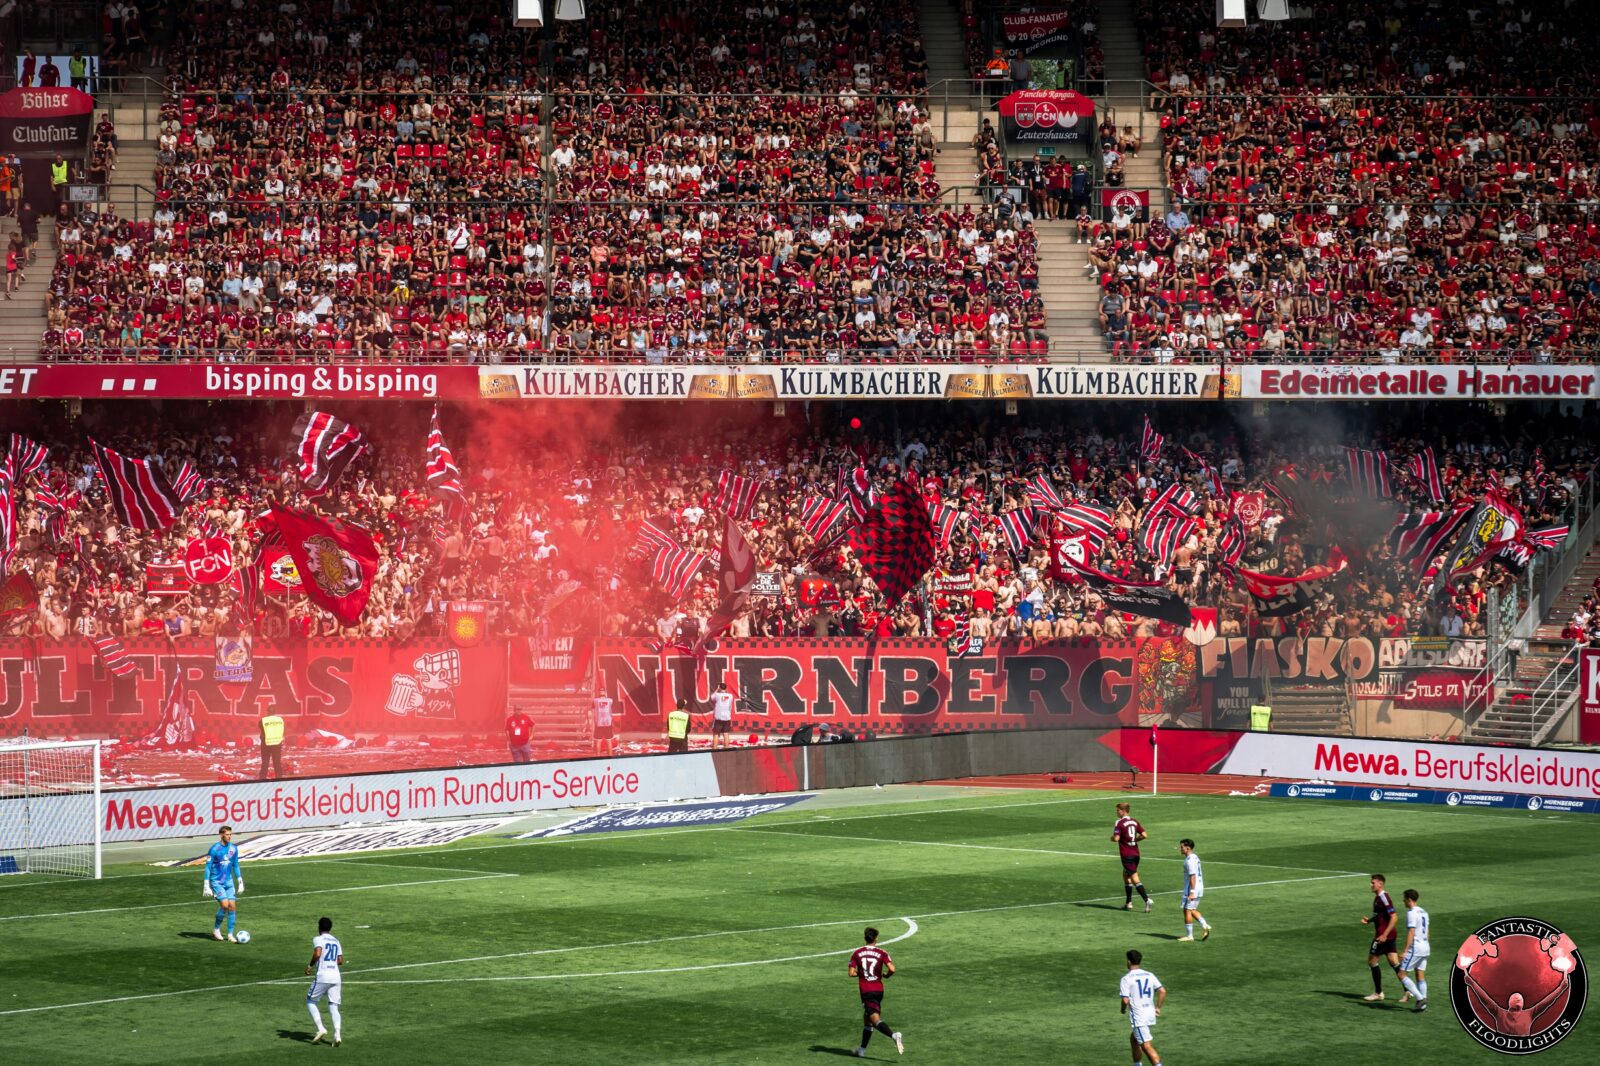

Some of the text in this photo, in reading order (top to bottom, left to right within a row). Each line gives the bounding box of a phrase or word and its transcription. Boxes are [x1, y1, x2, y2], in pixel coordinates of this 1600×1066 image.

[1003, 11, 1069, 25] CLUB-FANATICS
[1018, 32, 1028, 41] 20
[21, 91, 69, 111] Böhse
[1018, 90, 1075, 101] Fanclub Rangau
[1036, 112, 1056, 121] FCN
[1042, 104, 1050, 112] 1.
[12, 125, 79, 143] Clubfanz
[1016, 129, 1079, 140] Leutershausen
[206, 366, 437, 397] bisping & bisping
[524, 367, 686, 396] KULMBACHER
[780, 367, 942, 395] KULMBACHER
[1036, 367, 1198, 395] KULMBACHER
[1457, 369, 1595, 395] Hanauer
[189, 549, 231, 578] FCN
[1200, 636, 1376, 681] FIASKO
[598, 642, 1134, 717] NÜRNBERG
[1230, 686, 1249, 698] YOU
[427, 699, 452, 712] 1994
[1217, 697, 1241, 709] WILL
[1314, 743, 1408, 777] Mewa.
[105, 766, 639, 832] Mewa. Berufskleidung im Rundum-Service
[1463, 794, 1504, 802] NÜRNBERGER
[1543, 799, 1584, 808] NÜRNBERGER
[324, 942, 338, 962] 20
[861, 957, 878, 977] 17
[1135, 978, 1151, 999] 14
